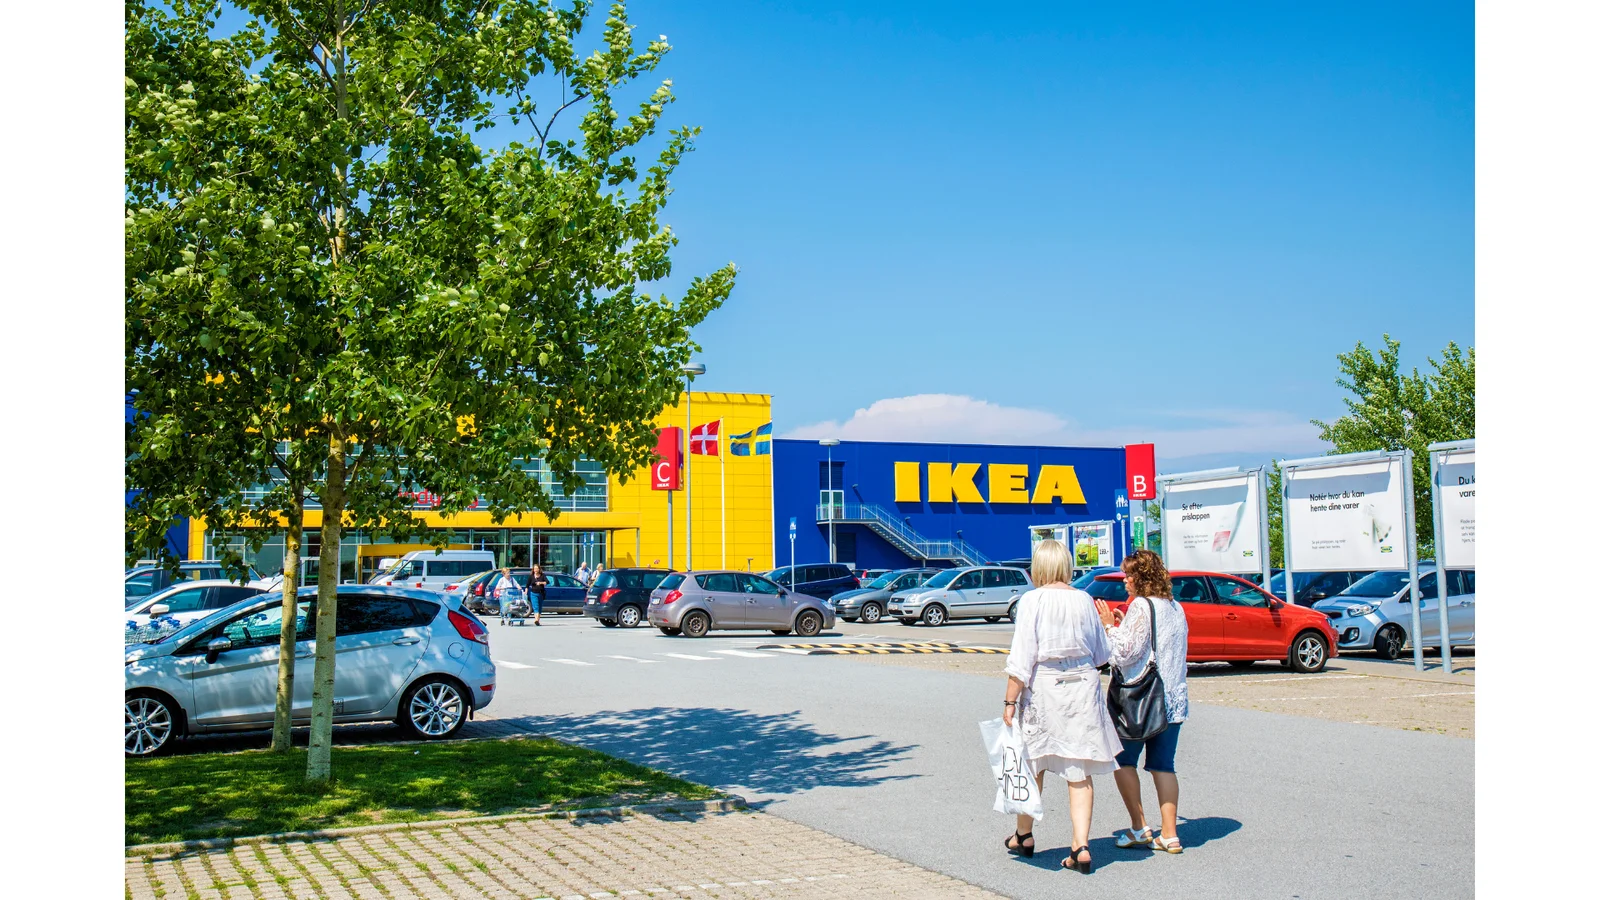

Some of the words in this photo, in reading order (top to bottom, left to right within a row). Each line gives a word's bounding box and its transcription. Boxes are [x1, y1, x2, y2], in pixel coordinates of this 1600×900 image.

[657, 462, 670, 483] C
[894, 461, 1087, 505] IKEA
[1133, 475, 1147, 493] B
[1458, 476, 1470, 485] Du
[1328, 492, 1341, 500] hvor
[1342, 490, 1350, 499] du
[1352, 490, 1365, 498] kan
[1182, 503, 1188, 511] Se
[1189, 502, 1203, 511] efter
[1310, 504, 1327, 512] hente
[1328, 502, 1341, 511] dine
[1342, 502, 1360, 510] varer
[1182, 513, 1210, 522] prislappen
